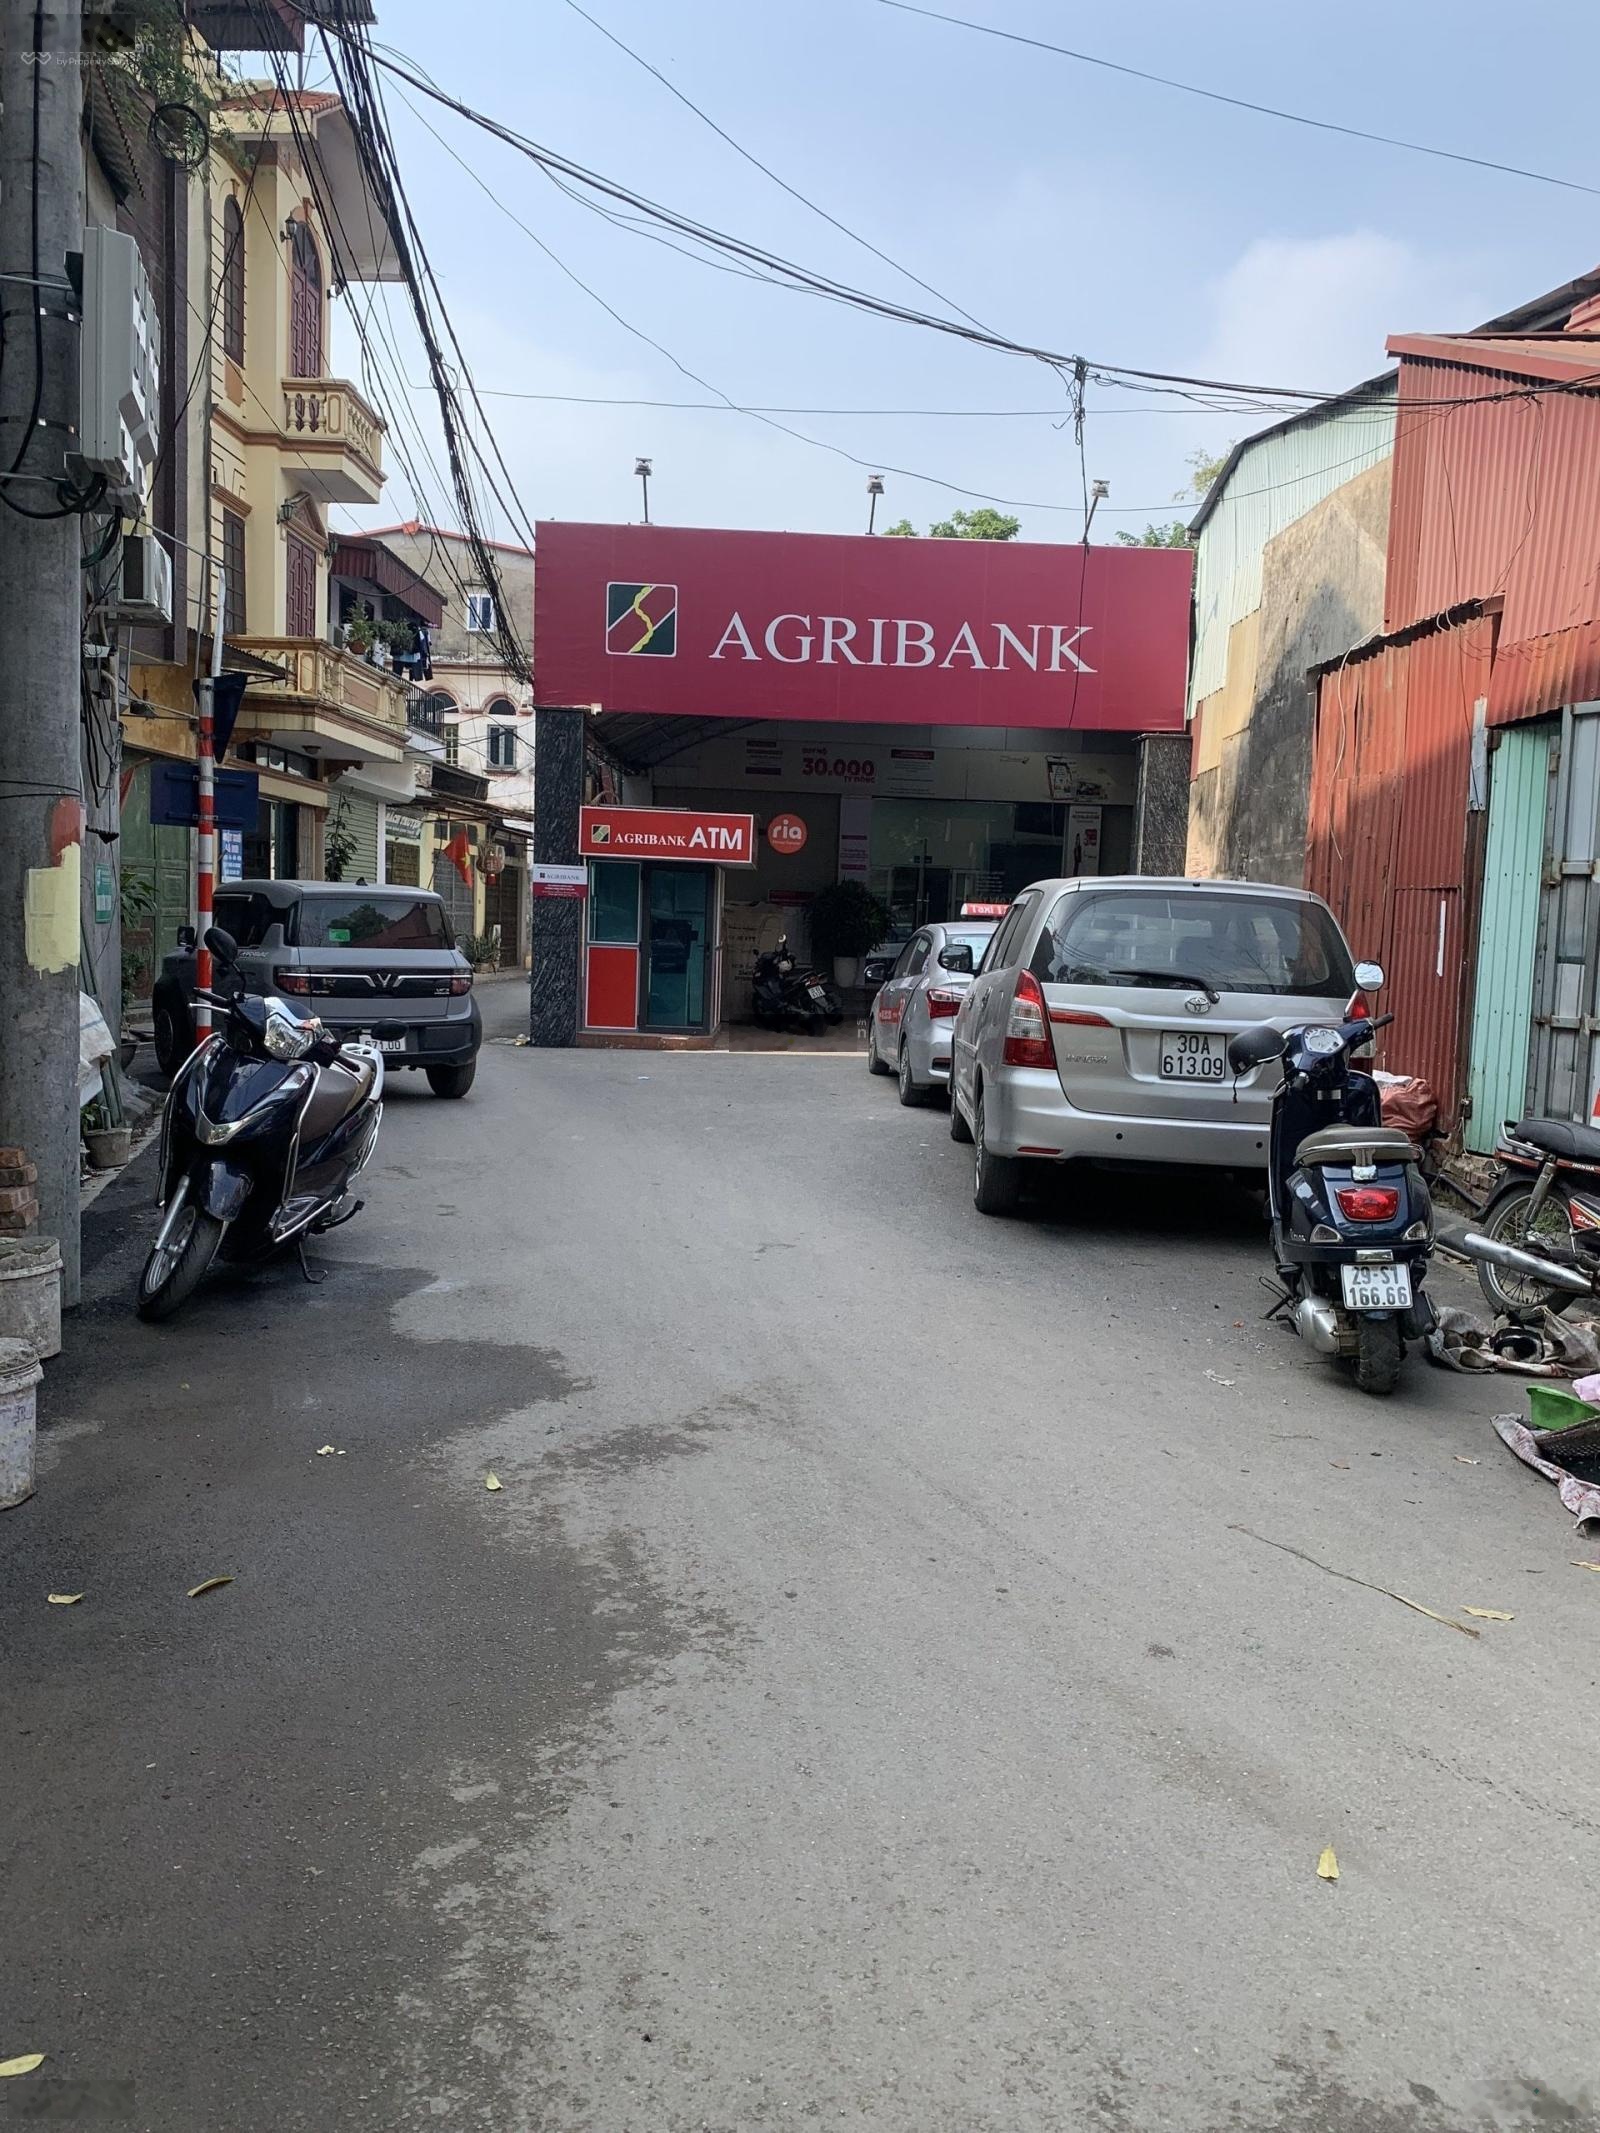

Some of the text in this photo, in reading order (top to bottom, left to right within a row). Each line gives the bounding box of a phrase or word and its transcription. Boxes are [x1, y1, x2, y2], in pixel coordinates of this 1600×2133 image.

[709, 611, 1098, 675] AGRIBANK
[802, 757, 875, 776] 30.000
[615, 825, 743, 850] AGRIBANK ATM
[772, 819, 802, 840] ria
[971, 903, 994, 914] Taxi
[1177, 1034, 1210, 1055] 30A
[1163, 1055, 1223, 1077] 613.09
[1571, 1162, 1595, 1172] HONDA
[1349, 1286, 1408, 1306] 166.66
